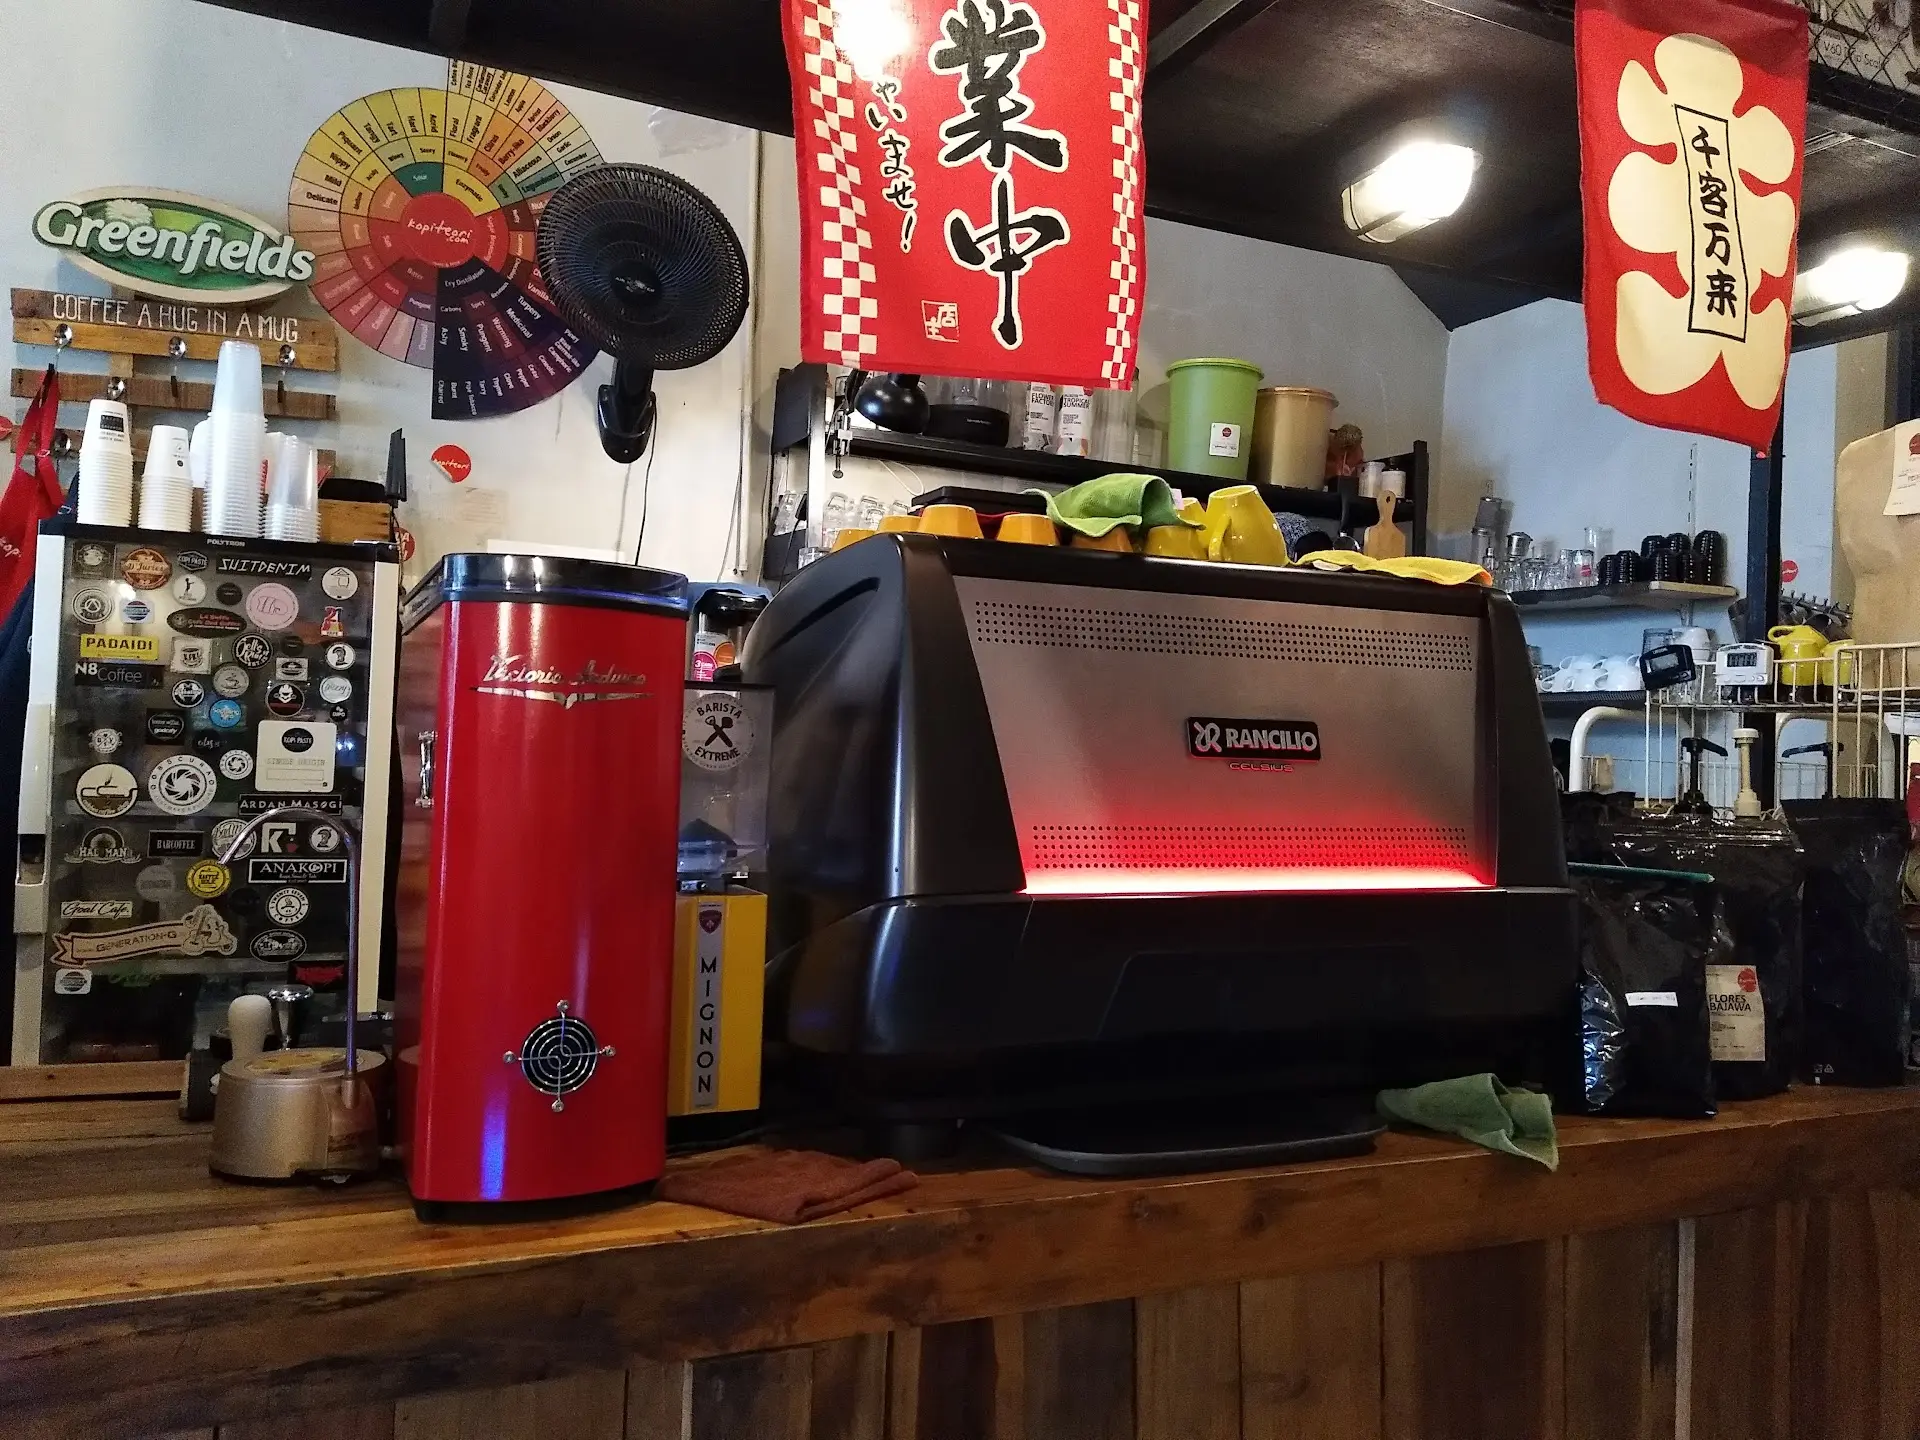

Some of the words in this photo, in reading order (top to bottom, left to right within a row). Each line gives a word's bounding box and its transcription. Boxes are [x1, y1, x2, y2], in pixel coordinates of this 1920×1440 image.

[306, 191, 338, 205] Delicate
[1691, 126, 1737, 318] 千客万来
[36, 204, 315, 281] Greenfields
[53, 294, 128, 325] COFFEE
[138, 303, 152, 329] A
[159, 305, 198, 332] HUG
[207, 309, 227, 335] IN
[236, 313, 253, 338] A
[258, 316, 298, 343] MUG
[506, 308, 533, 339] Medicinal
[440, 327, 448, 346] Ashy
[458, 327, 469, 352] Smoky
[476, 323, 492, 352] Pungent
[492, 317, 512, 348] Warming
[207, 538, 246, 547] POLYTRON
[75, 662, 98, 676] N8
[98, 668, 142, 684] Coffee
[697, 702, 743, 719] BARISTA
[1225, 728, 1317, 751] RANCILIO
[694, 746, 741, 762] EXTREME
[1229, 762, 1295, 772] CELSIUS
[240, 800, 286, 809] ARDAN
[260, 862, 337, 873] ANAKOPI
[1709, 994, 1747, 1003] FLORES
[696, 956, 718, 1093] MIGNON
